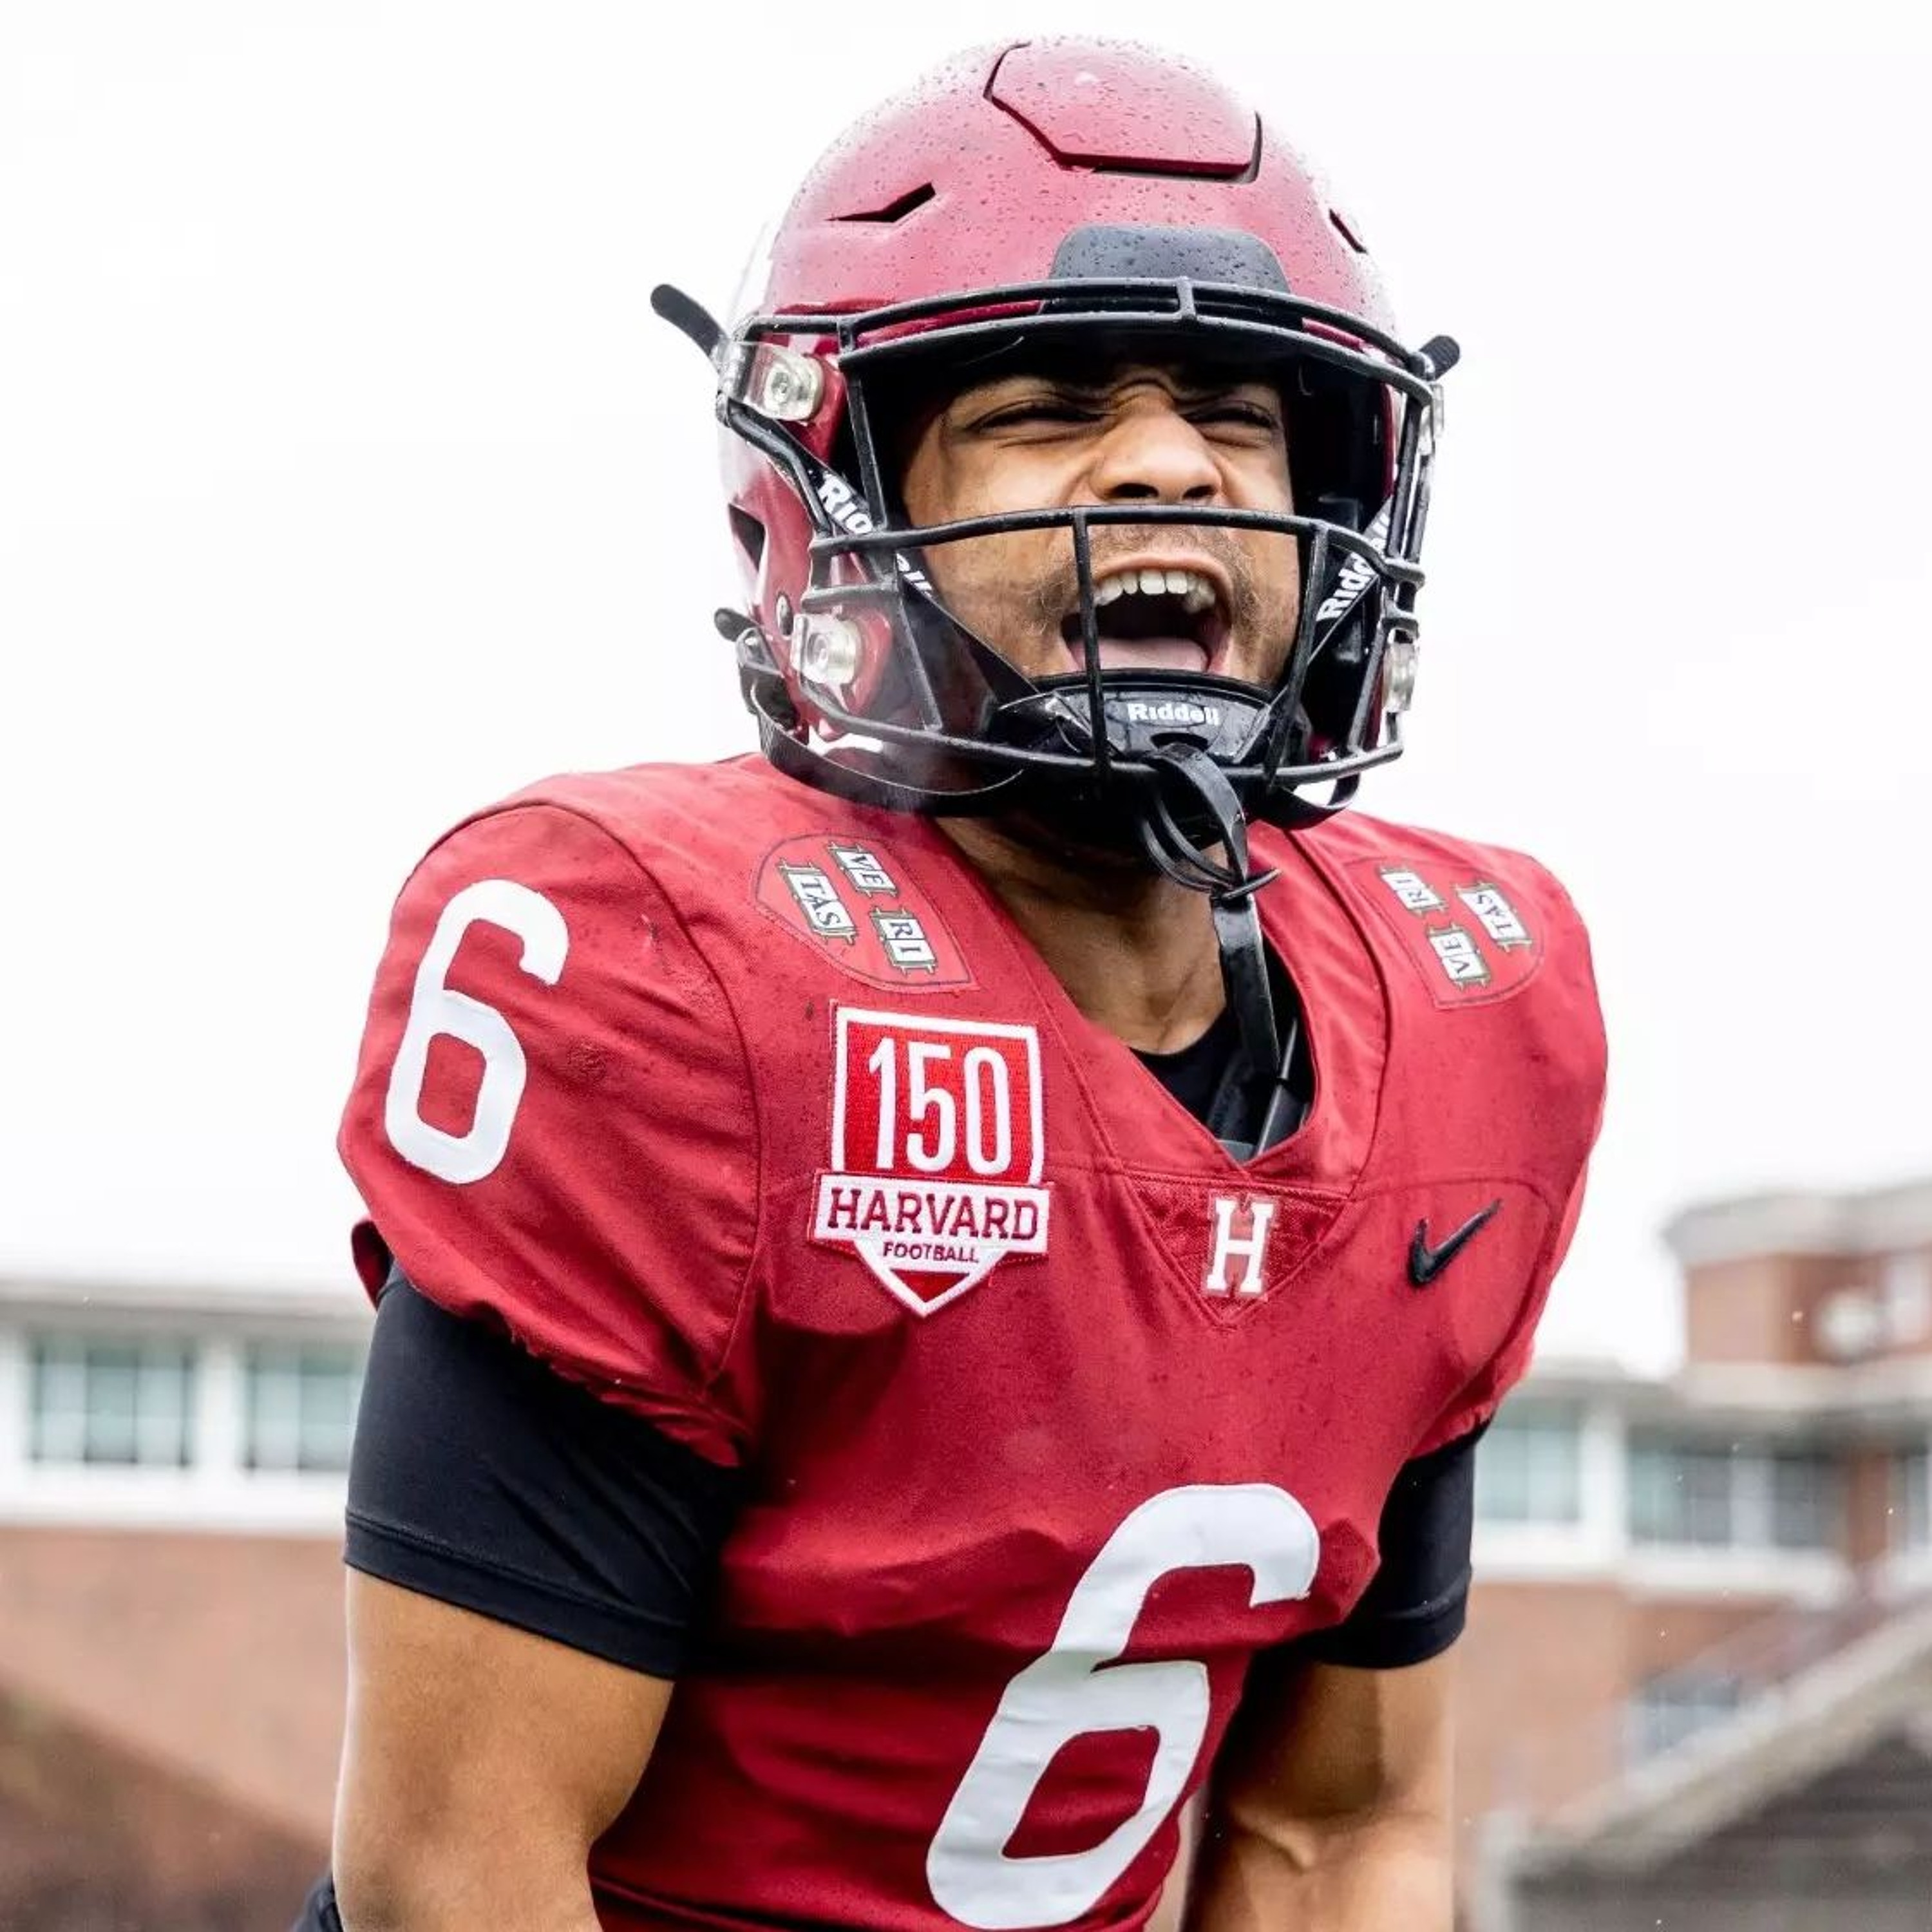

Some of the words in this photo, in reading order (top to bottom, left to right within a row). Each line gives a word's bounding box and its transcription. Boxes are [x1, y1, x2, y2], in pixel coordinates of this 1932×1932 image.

[817, 471, 933, 591] Ridll
[1127, 703, 1220, 726] Riddell
[850, 855, 885, 887] VE
[801, 880, 841, 927] TAS
[1477, 894, 1511, 935] TAS
[890, 922, 922, 953] RI
[1443, 936, 1470, 974] VE
[385, 879, 569, 1184] 6
[869, 1037, 1012, 1175] 150
[828, 1188, 1039, 1240] HARVARD
[883, 1241, 980, 1264] FOOTBALL
[1207, 1198, 1274, 1293] H
[926, 1483, 1320, 1930] 6
